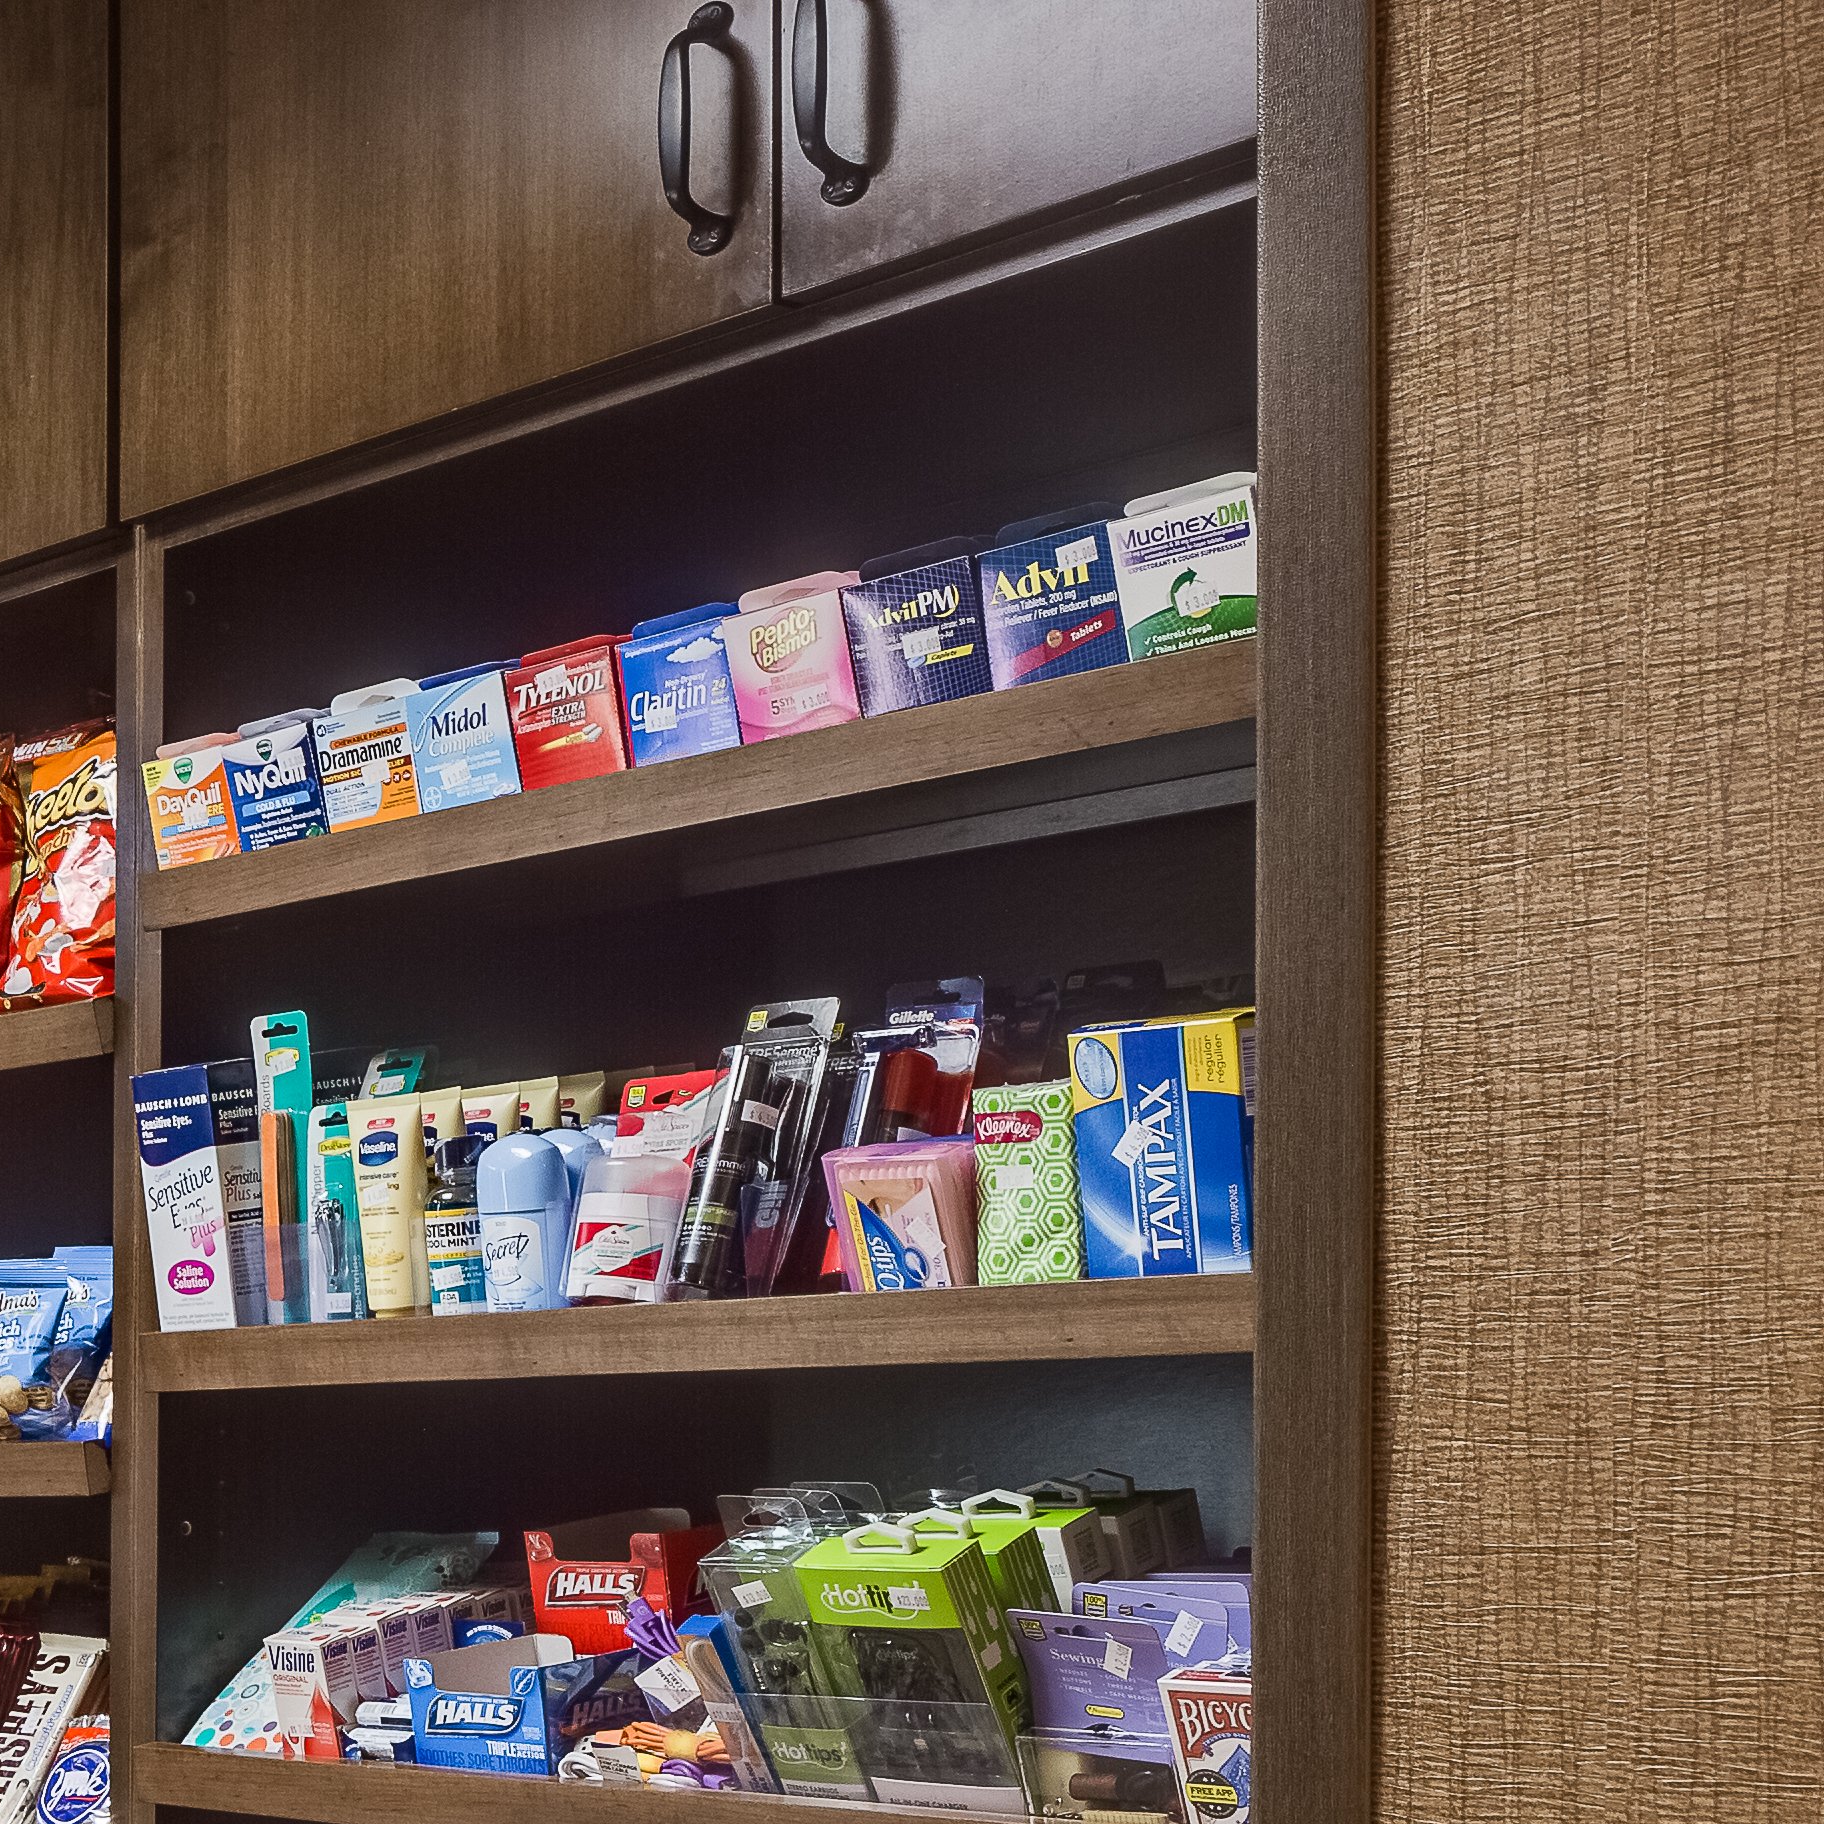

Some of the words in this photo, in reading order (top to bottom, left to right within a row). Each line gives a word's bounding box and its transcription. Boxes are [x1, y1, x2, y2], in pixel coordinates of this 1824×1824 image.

[1216, 500, 1248, 527] DM
[991, 561, 1089, 605] Advil
[863, 601, 918, 631] Advil
[918, 585, 953, 615] PM
[1070, 620, 1102, 641] Tablets
[762, 626, 816, 667] Bismol
[552, 700, 585, 716] EXTRA
[631, 682, 706, 722] Claritin
[431, 703, 487, 738] Midol
[551, 710, 586, 725] STRENGTH
[320, 737, 402, 773] Dramamine
[429, 729, 494, 758] Complete
[234, 766, 306, 800] NyQuil
[156, 783, 222, 817] DayQuil
[889, 1010, 936, 1026] Gillette
[1204, 1034, 1214, 1082] regular
[135, 1100, 171, 1113] BAUSCH
[179, 1094, 208, 1107] LOMB
[141, 1117, 170, 1131] Sensitive
[977, 1114, 1032, 1139] Kleenex
[360, 1140, 395, 1155] Vaseline
[1138, 1078, 1185, 1261] TAMPAX
[148, 1164, 214, 1212] Sensitive
[190, 1220, 216, 1241] Plus
[448, 1238, 477, 1247] MINT
[485, 1233, 529, 1271] Secret
[173, 1275, 210, 1290] Solution
[176, 1265, 204, 1279] Saline
[555, 1573, 636, 1597] HALLS
[268, 1645, 315, 1675] Visine
[1050, 1647, 1103, 1668] Sewing
[273, 1674, 308, 1684] ORIGINAL
[435, 1702, 517, 1727] HALLS
[486, 1741, 516, 1756] TRIPLE
[517, 1750, 545, 1760] ACTION
[419, 1749, 462, 1767] SOOTHES
[465, 1754, 493, 1770] SORE
[496, 1755, 546, 1774] THROATS
[50, 1760, 107, 1806] York
[1190, 1785, 1214, 1797] FREE
[1216, 1787, 1233, 1798] APP
